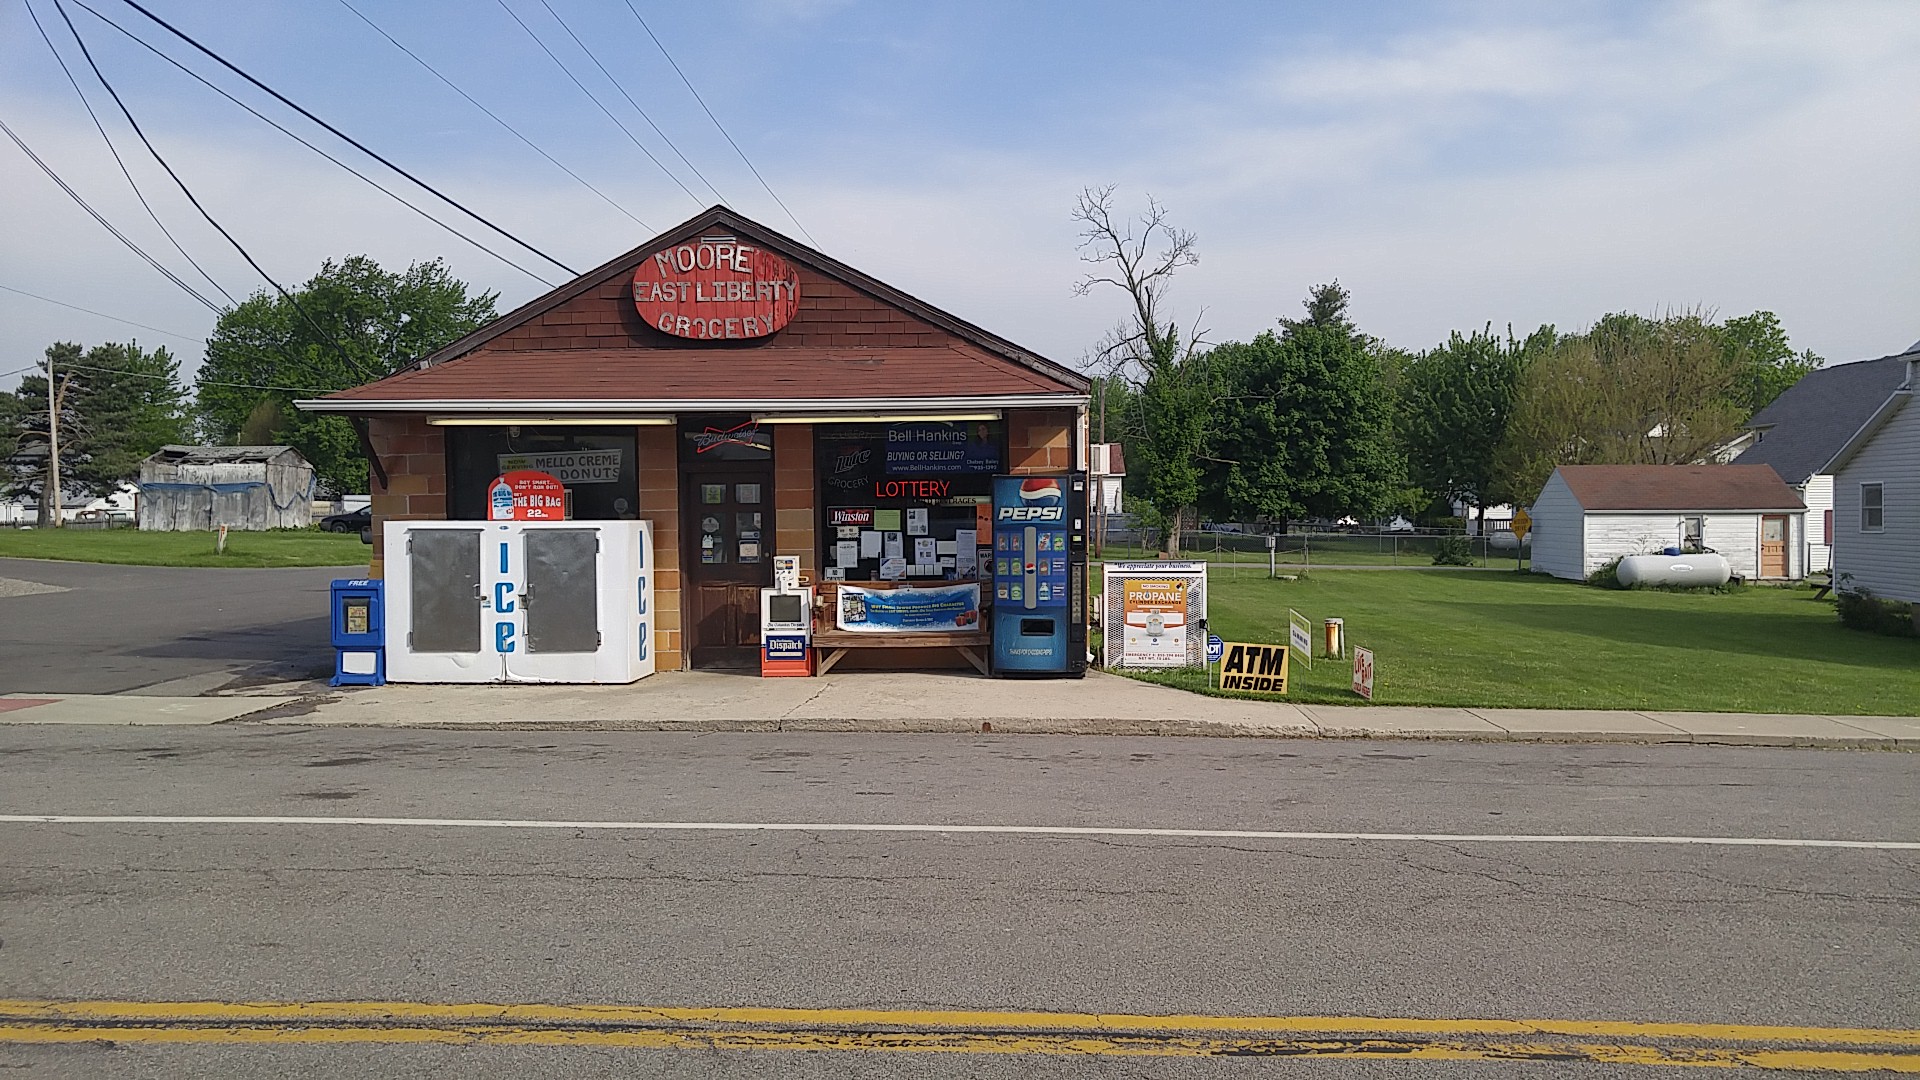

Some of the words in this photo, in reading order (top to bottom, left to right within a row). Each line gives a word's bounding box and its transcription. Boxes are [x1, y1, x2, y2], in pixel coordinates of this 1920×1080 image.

[655, 245, 754, 279] MOORE
[635, 281, 691, 302] EAST
[696, 281, 796, 302] LIBERTY
[658, 312, 774, 339] GROCERY
[693, 429, 759, 446] Budweiser
[888, 430, 912, 442] Bell
[916, 429, 967, 442] Hankins
[536, 456, 575, 469] MELLO
[579, 454, 619, 467] CREME
[887, 452, 915, 461] BUYING
[917, 451, 928, 461] OR
[929, 451, 965, 461] SELLING?
[560, 467, 620, 480] DONUTS
[892, 463, 962, 471] www.BellHankins.com
[828, 475, 869, 489] GROCERY
[876, 481, 951, 497] LOTTERY
[514, 496, 528, 507] THE
[529, 494, 544, 507] BIG
[545, 495, 562, 507] BAG
[834, 510, 870, 522] Winston
[998, 507, 1064, 521] PEPSI
[1126, 563, 1155, 571] appreciate
[1155, 563, 1167, 571] your
[1129, 591, 1182, 601] PROPANE
[769, 639, 803, 652] Dispatch
[1224, 645, 1285, 676] ATM
[1223, 675, 1285, 692] INSIDE
